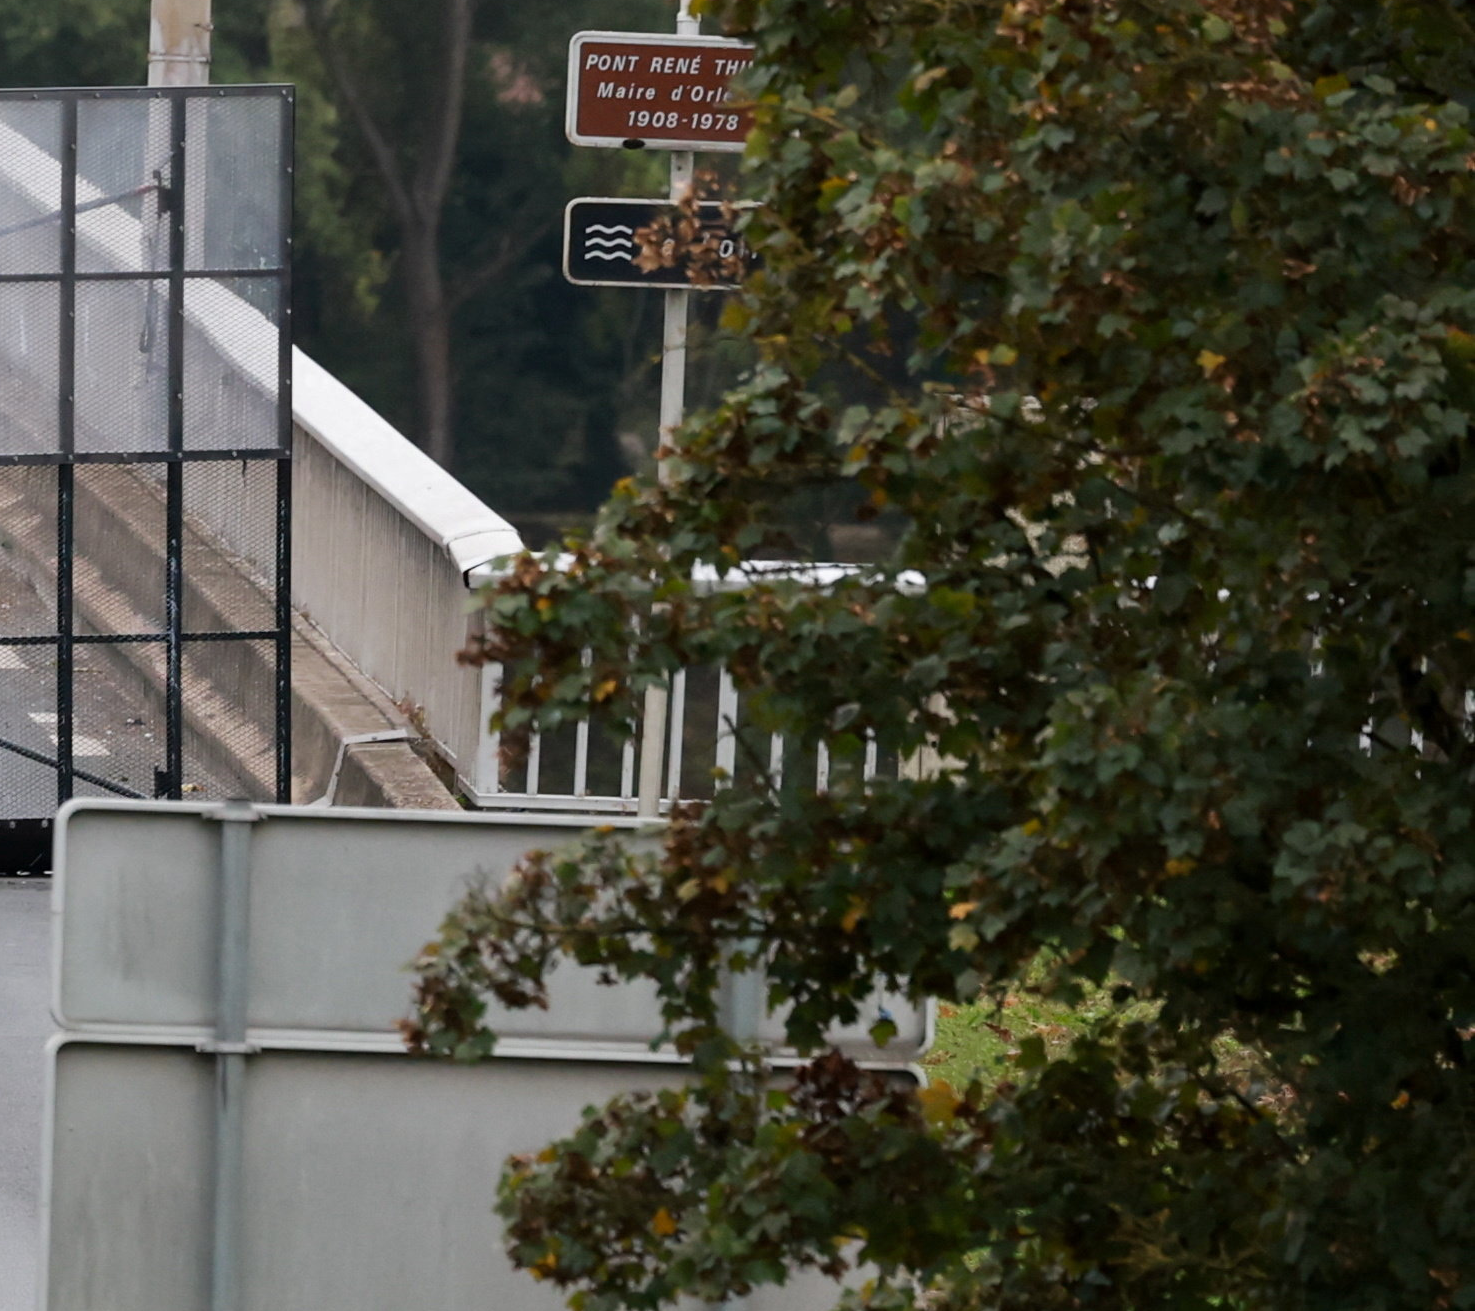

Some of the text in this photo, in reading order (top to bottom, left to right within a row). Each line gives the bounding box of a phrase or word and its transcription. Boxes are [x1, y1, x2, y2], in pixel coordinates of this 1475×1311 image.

[585, 53, 639, 72] PONT
[650, 54, 702, 75] RENÉ
[597, 82, 656, 100] Maire
[628, 110, 739, 131] 1908-1978
